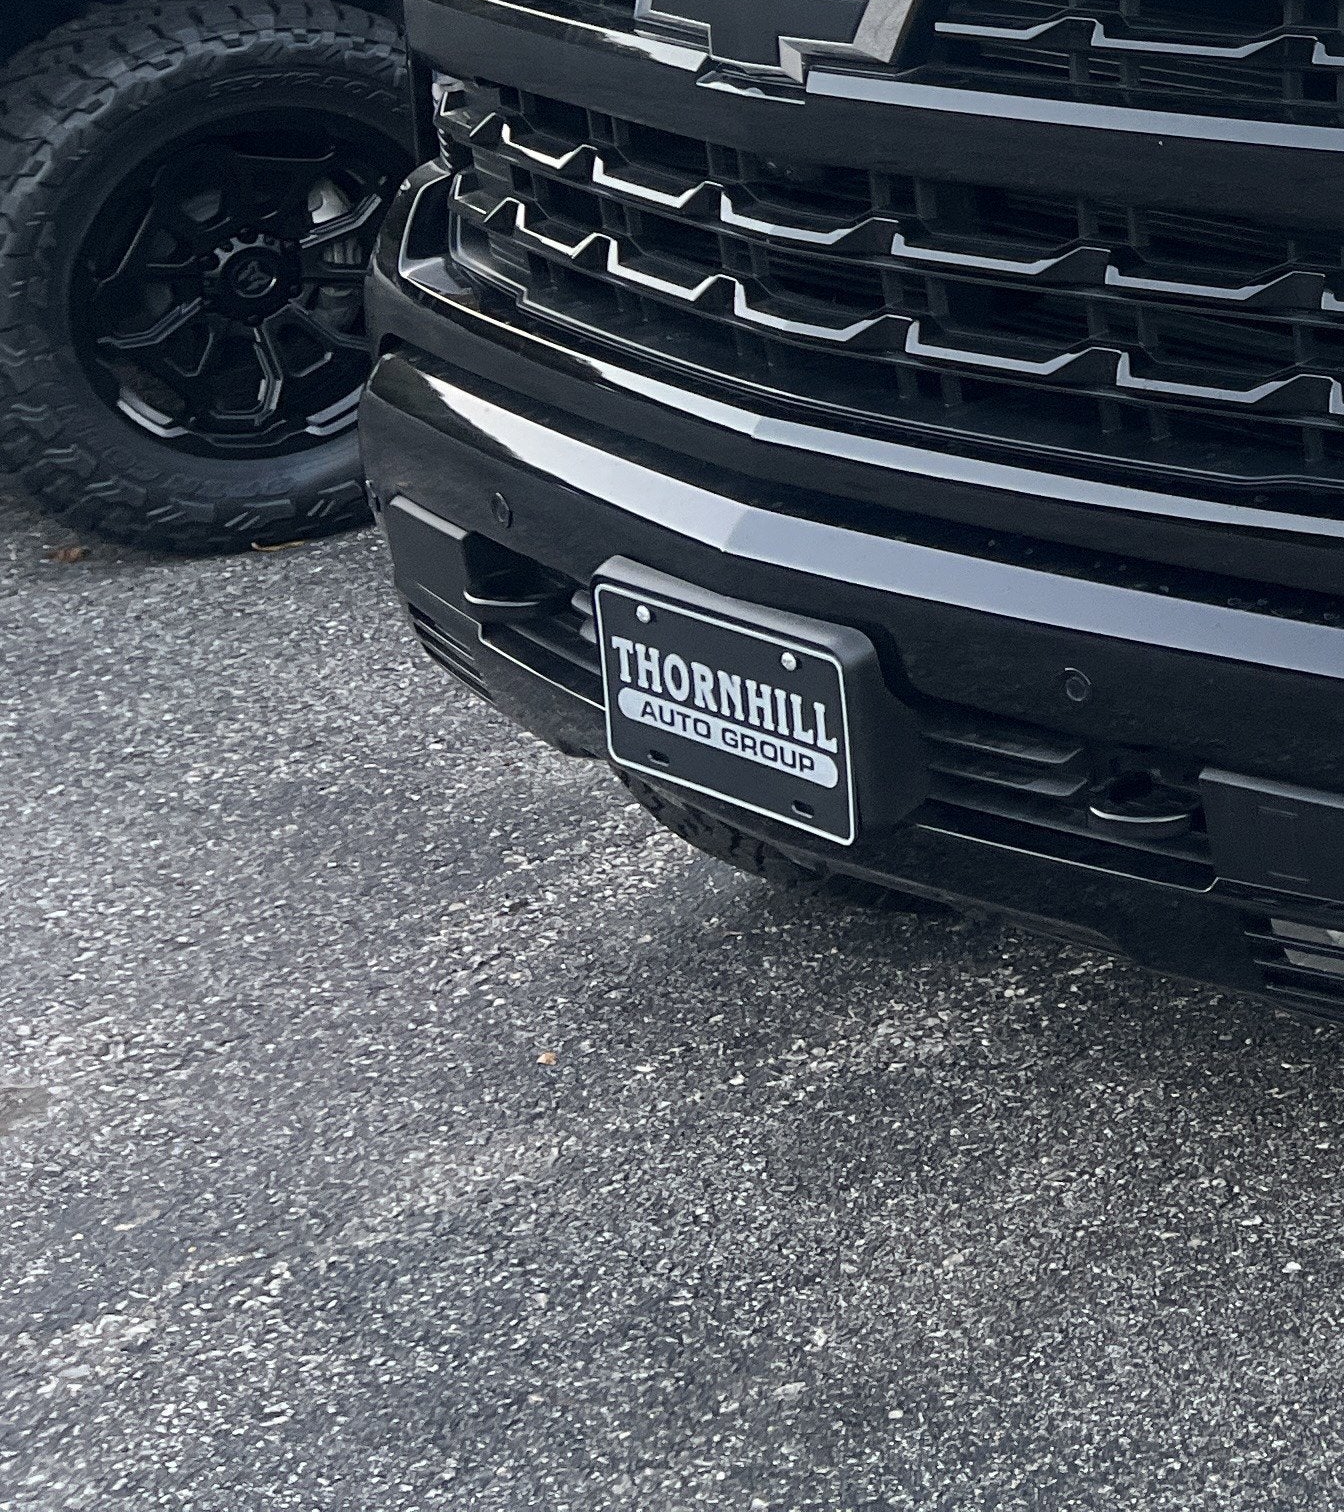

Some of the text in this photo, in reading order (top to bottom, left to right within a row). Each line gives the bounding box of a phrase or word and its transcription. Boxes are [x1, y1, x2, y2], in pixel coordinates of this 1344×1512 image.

[611, 635, 838, 754] THORNHILL
[641, 701, 815, 773] AUTO GROUP
